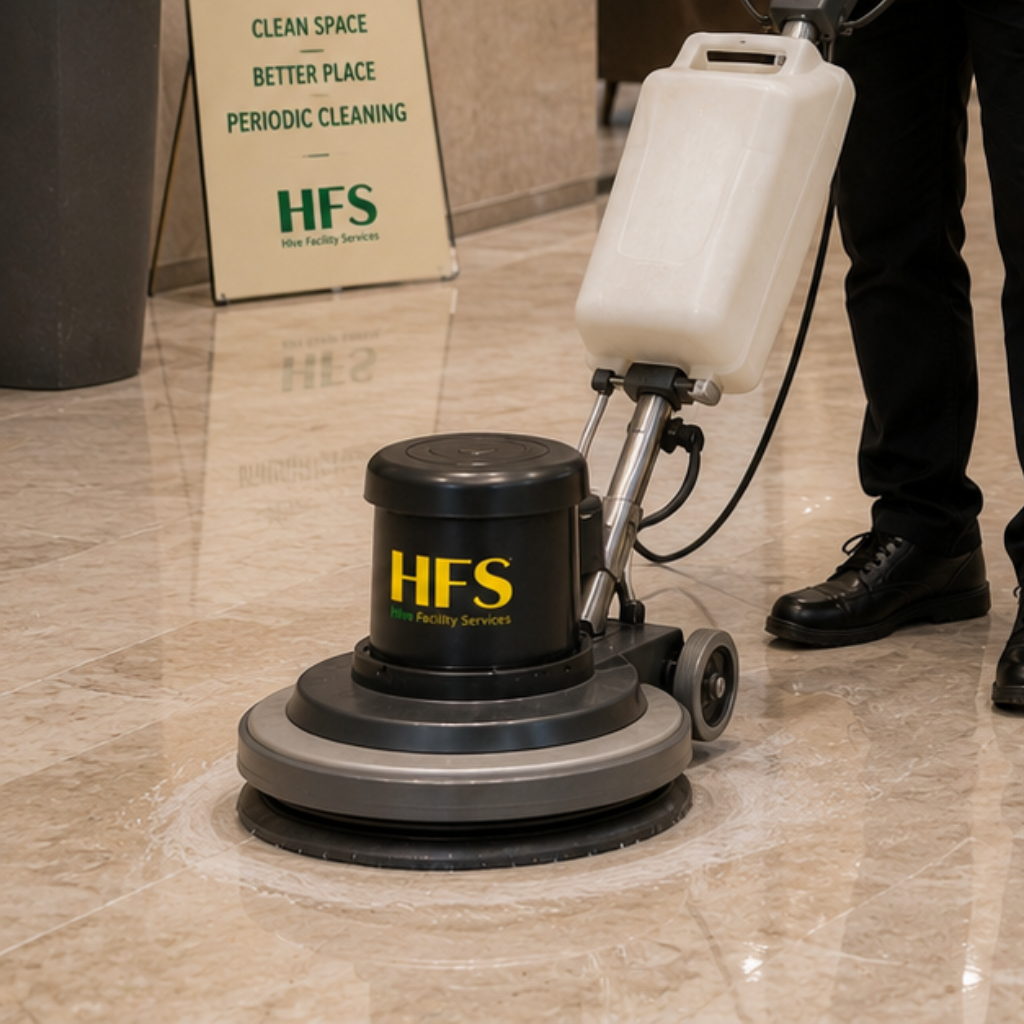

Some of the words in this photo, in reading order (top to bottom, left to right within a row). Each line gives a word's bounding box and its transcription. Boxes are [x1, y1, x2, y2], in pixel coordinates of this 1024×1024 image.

[252, 17, 309, 39] CLEAN
[314, 13, 368, 36] SPACE
[253, 64, 318, 87] BETTER
[323, 61, 376, 83] PLACE
[227, 108, 313, 133] PERIODIC
[318, 102, 407, 127] CLEANING
[277, 183, 378, 233] HFS
[281, 237, 303, 248] Hive
[305, 235, 339, 247] Facility
[341, 232, 380, 244] Services
[390, 549, 513, 609] HFS
[461, 614, 511, 626] Services
